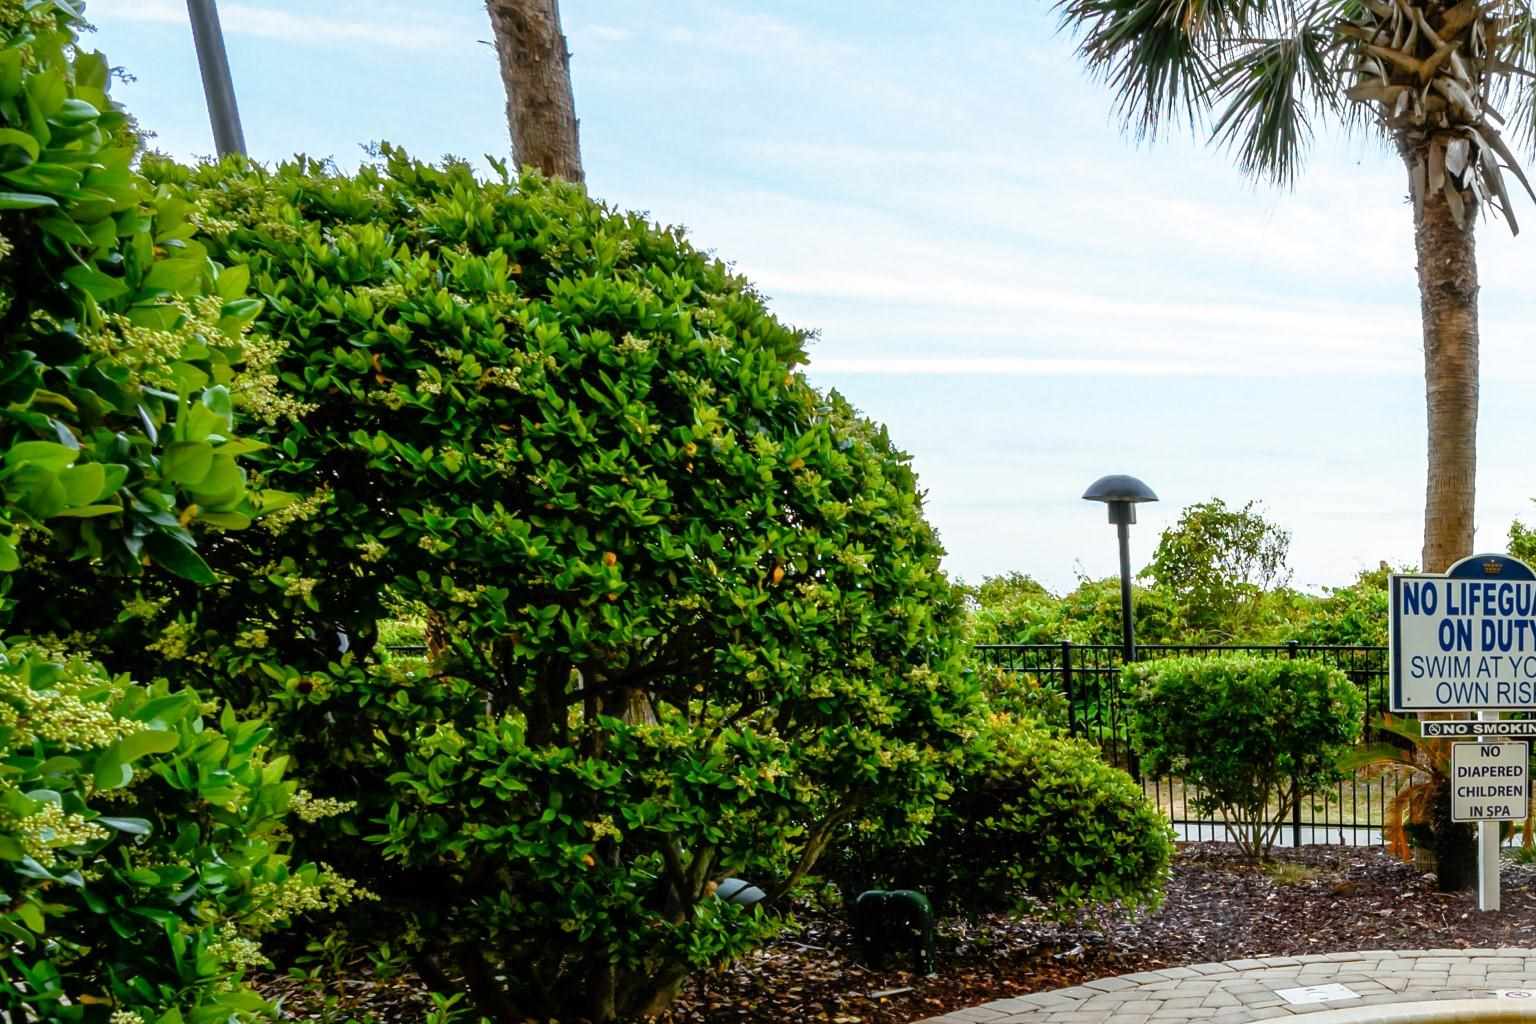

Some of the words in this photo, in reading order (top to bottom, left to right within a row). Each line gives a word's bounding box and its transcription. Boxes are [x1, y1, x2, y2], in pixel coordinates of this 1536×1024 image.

[1403, 581, 1438, 616] NO
[1438, 618, 1472, 652] ON
[1410, 655, 1471, 679] SWIM
[1476, 656, 1503, 678] AT
[1435, 682, 1489, 704] OWN
[1443, 723, 1468, 734] NO
[1480, 746, 1501, 757] NO
[1457, 766, 1523, 778] DIAPERED
[1457, 786, 1523, 797] CHILDREN
[1469, 806, 1483, 817] IN
[1486, 806, 1511, 817] SPA
